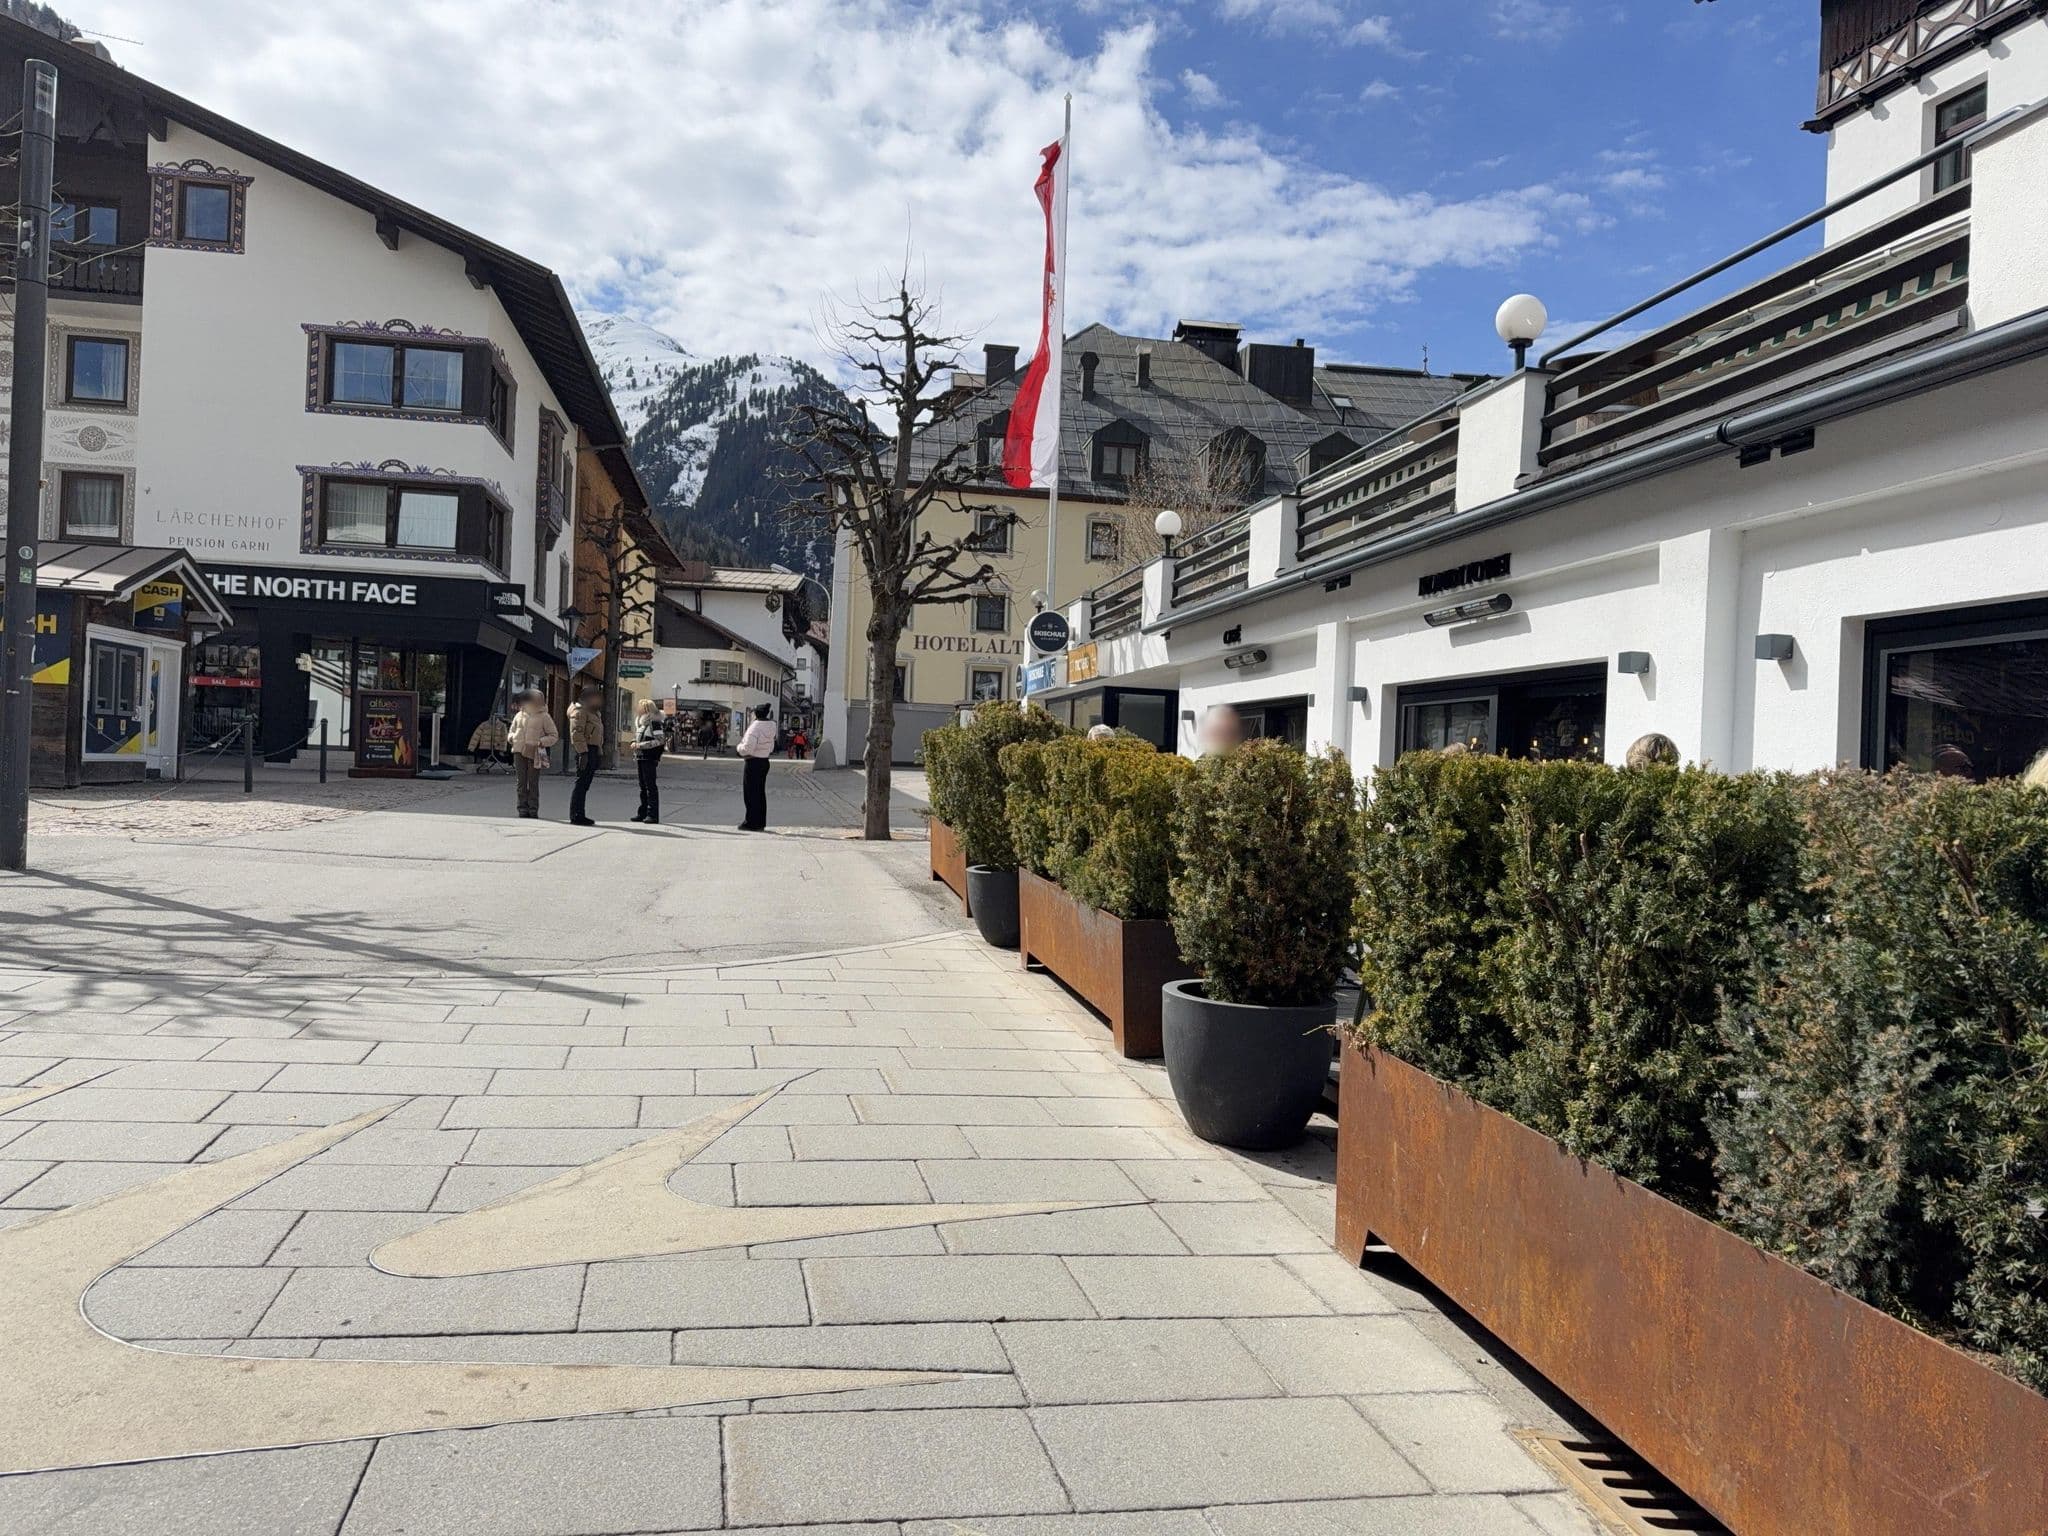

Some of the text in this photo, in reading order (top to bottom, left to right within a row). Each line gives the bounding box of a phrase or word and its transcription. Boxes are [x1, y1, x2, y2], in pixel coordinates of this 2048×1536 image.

[168, 535, 270, 552] PENSION GARNI
[141, 584, 179, 597] CASH
[253, 575, 346, 600] NORTH
[351, 581, 417, 605] FACE
[913, 634, 982, 653] HOTEL
